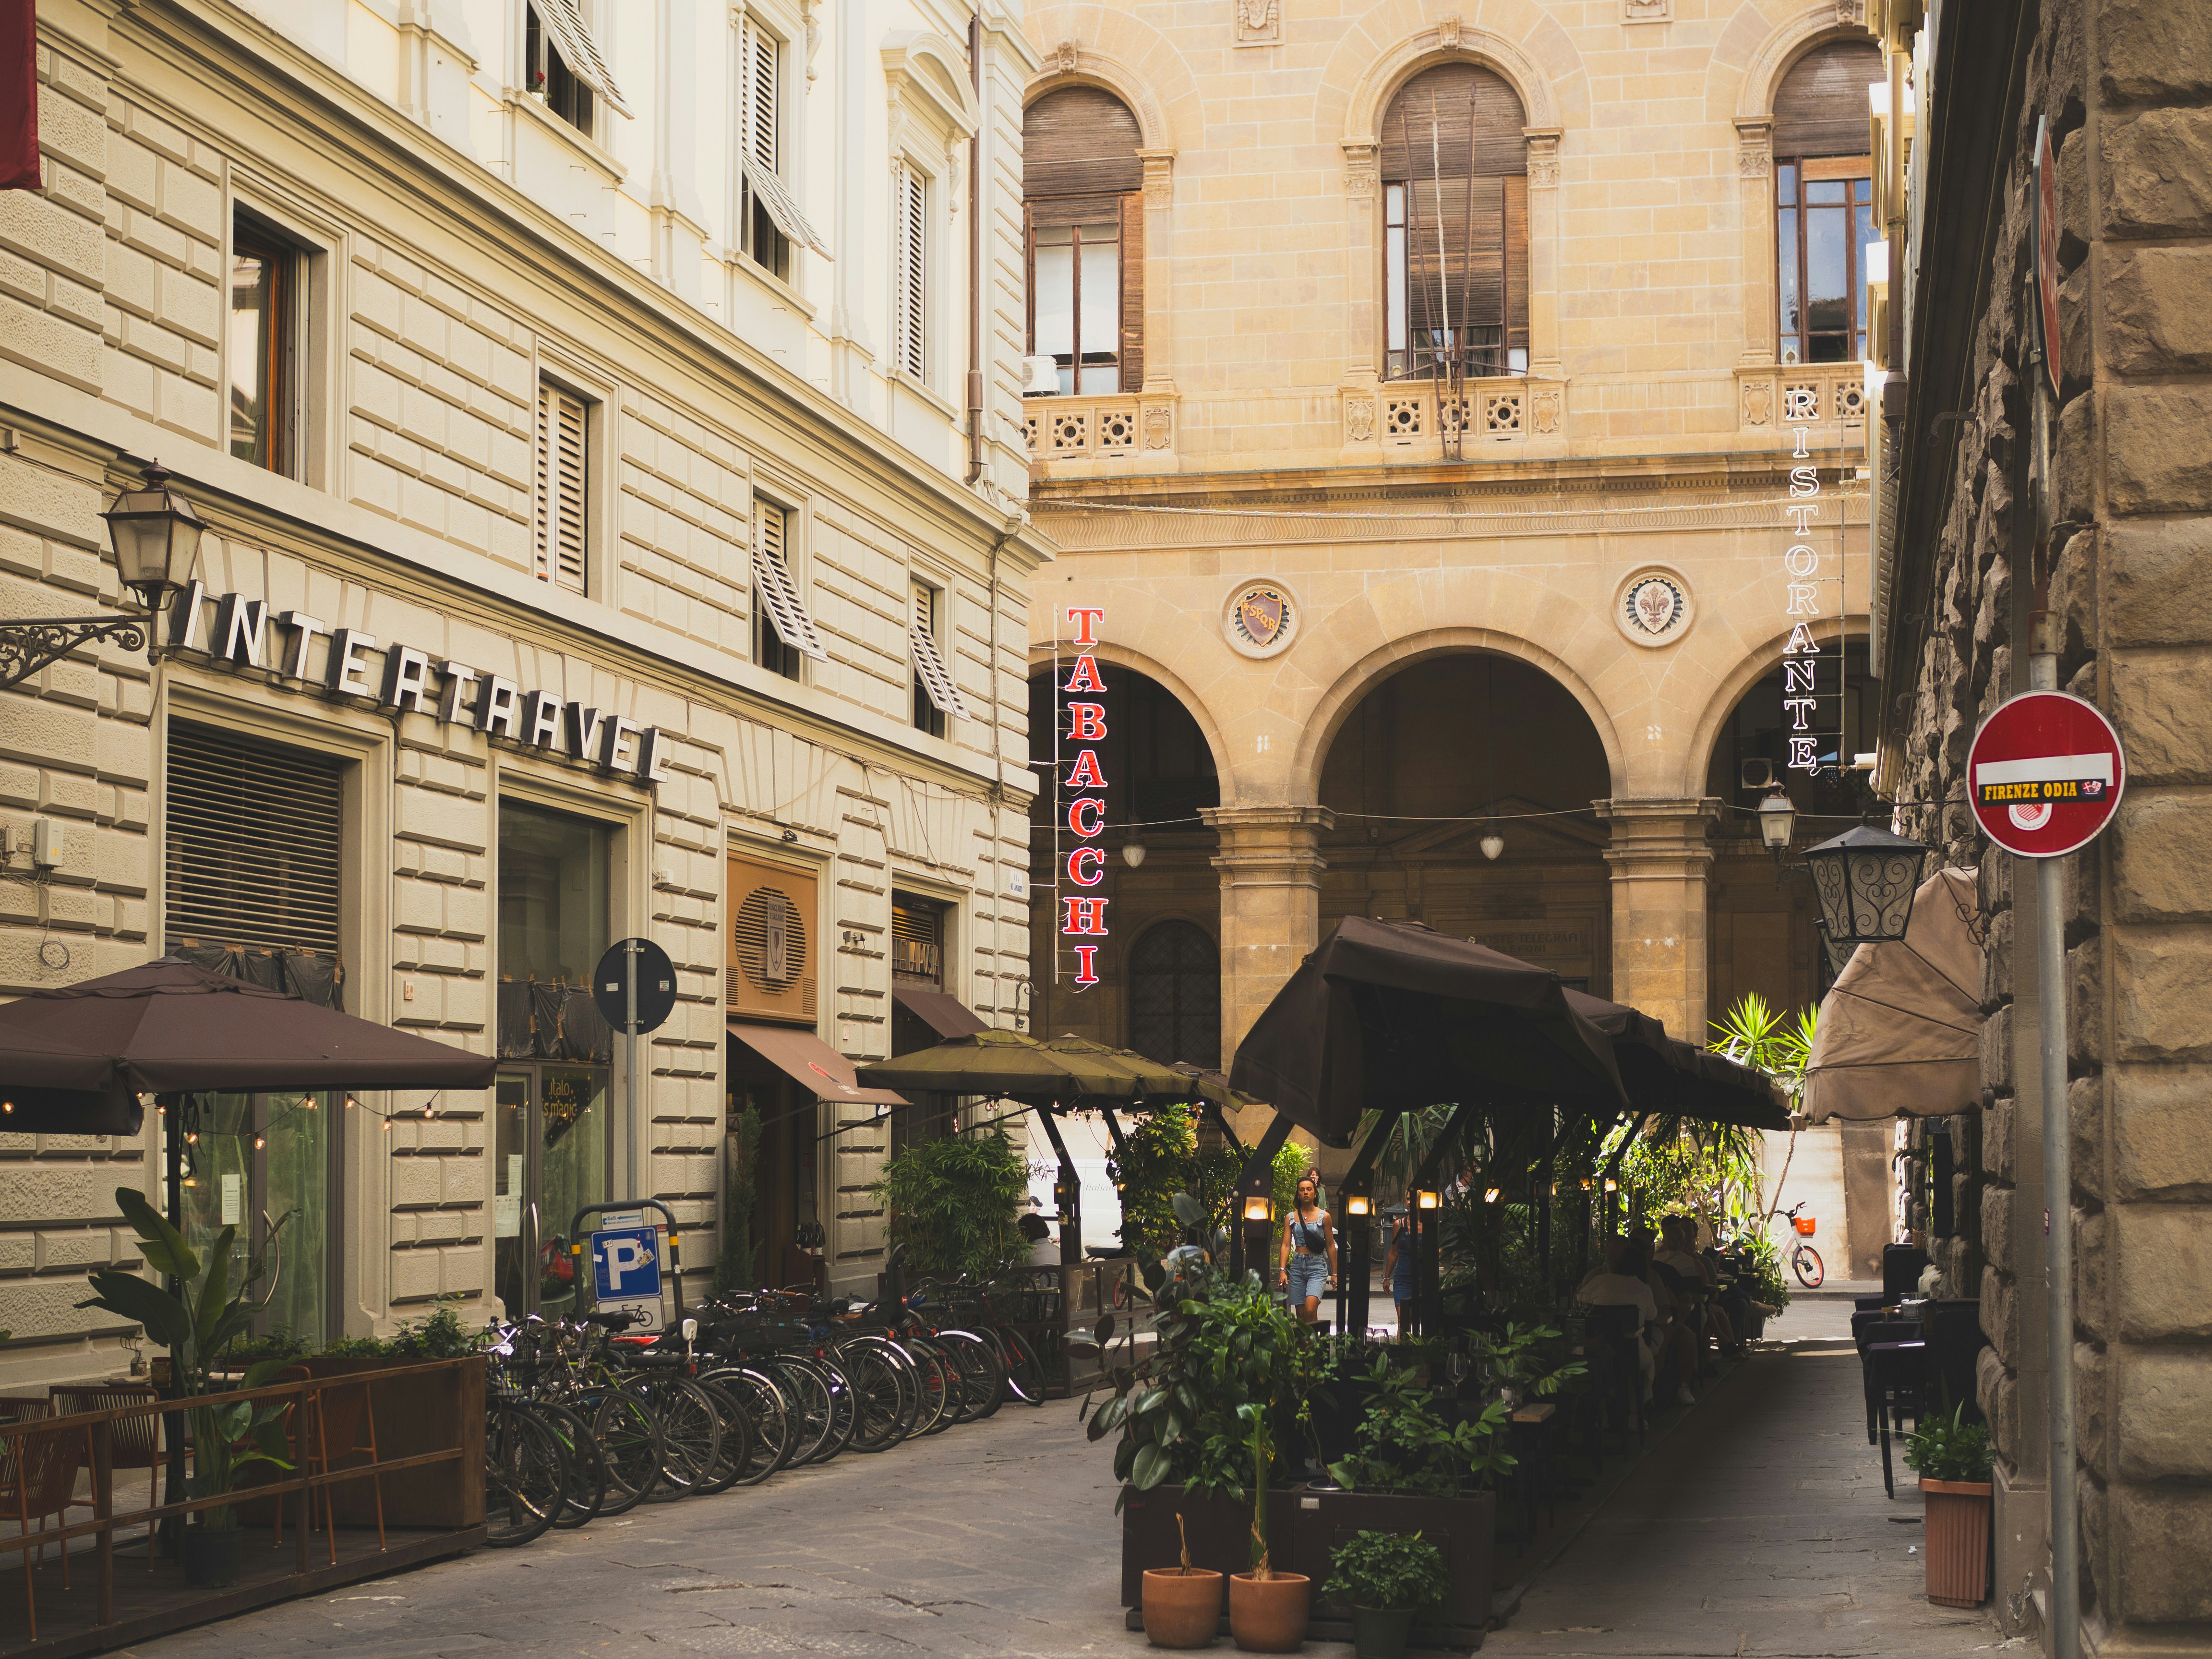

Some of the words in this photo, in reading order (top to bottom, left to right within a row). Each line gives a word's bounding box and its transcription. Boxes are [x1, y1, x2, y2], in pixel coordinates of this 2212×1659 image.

[2041, 190, 2057, 325] STOP
[1249, 605, 1276, 632] SPQR
[1783, 390, 1820, 769] RISTORANTE
[170, 578, 669, 783] INTERTRAVEL
[1062, 607, 1109, 983] TABACCHI
[1984, 783, 2039, 800] FIRENZE
[2044, 782, 2077, 797] ODIA
[1475, 933, 1514, 945] POSTE
[1519, 933, 1577, 943] TELEGRAFI
[607, 1238, 644, 1290] P
